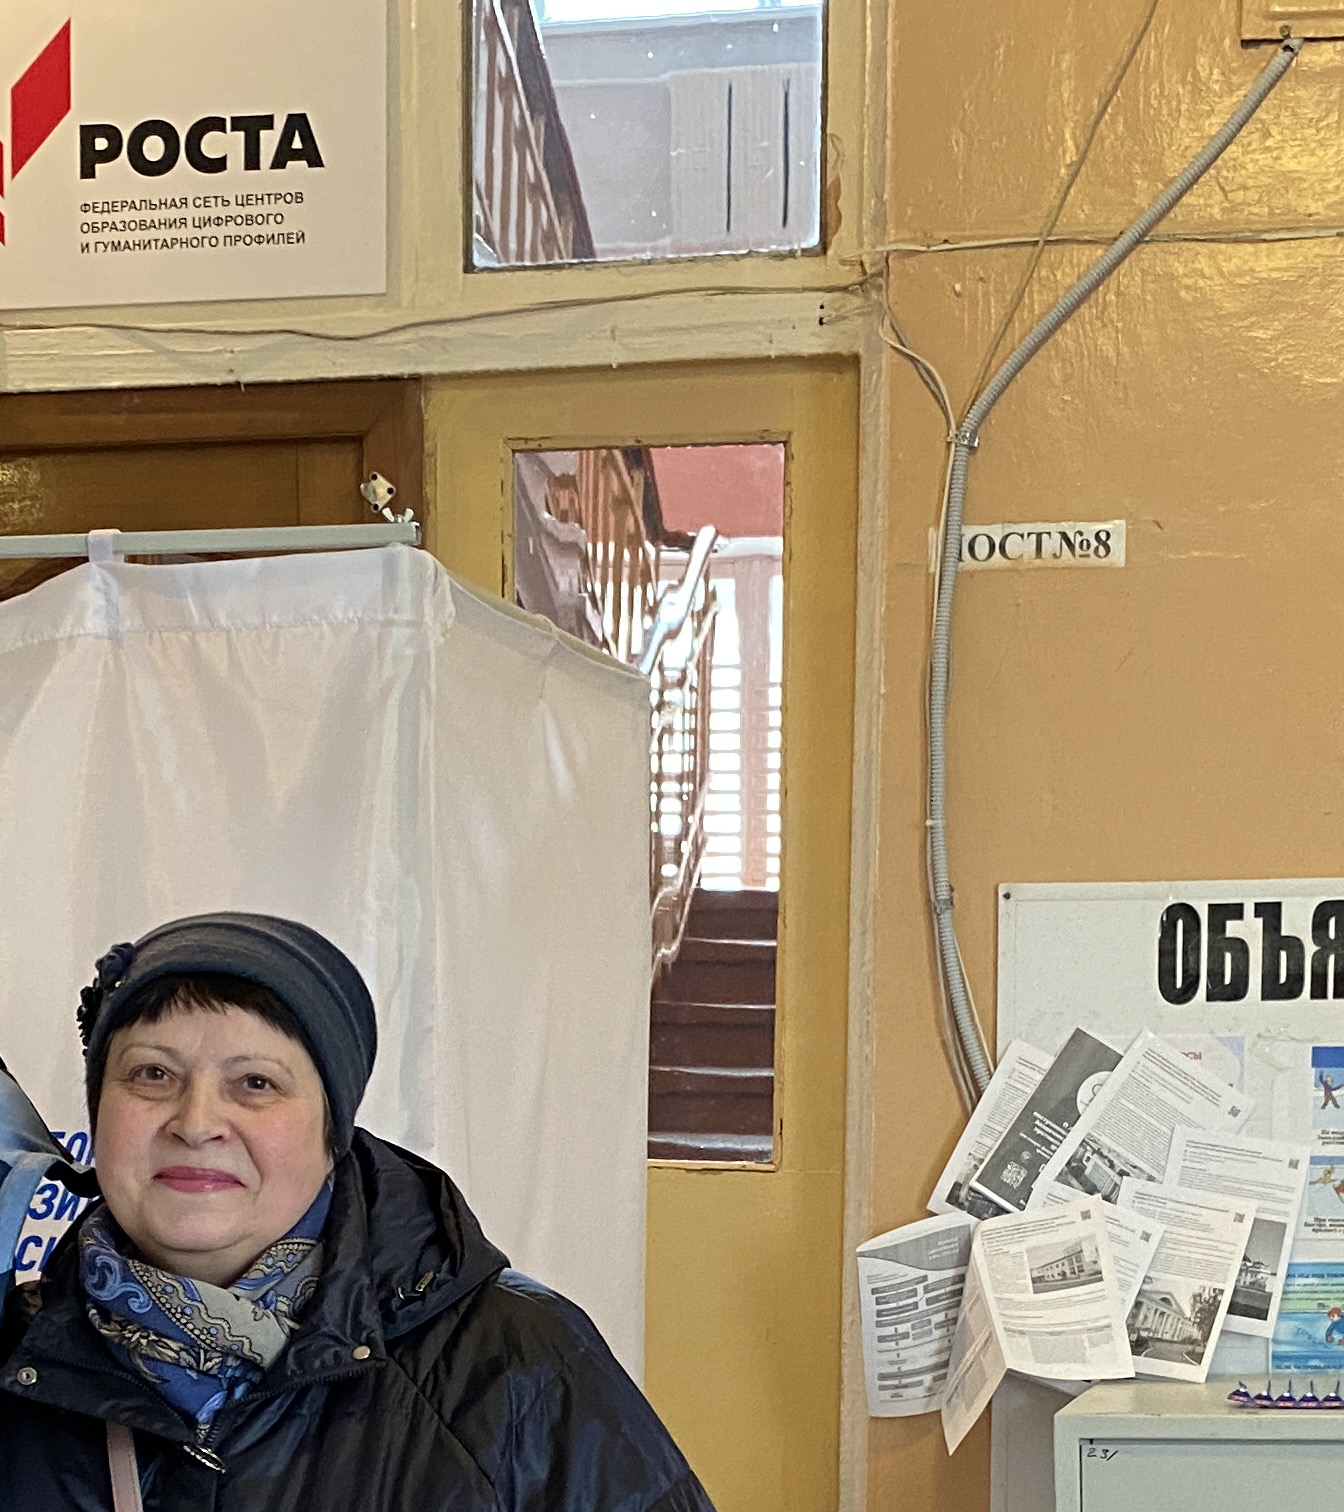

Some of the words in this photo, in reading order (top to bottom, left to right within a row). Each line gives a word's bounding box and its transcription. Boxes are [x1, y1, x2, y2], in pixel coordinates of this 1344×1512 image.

[78, 111, 325, 180] РОСТА
[80, 197, 188, 214] ФЕДЕРАЛЬНАЯ
[192, 194, 231, 209] СЕТЬ
[235, 191, 304, 208] ЦЕНТРОВ
[80, 217, 187, 234] ОБРАЗОВАНИЯ
[192, 212, 284, 230] ЦИФРОВОГО
[80, 242, 90, 254] И
[94, 235, 219, 254] ГУМАНИТАРНОГО
[223, 230, 306, 247] ПРОФИЛЕЙ
